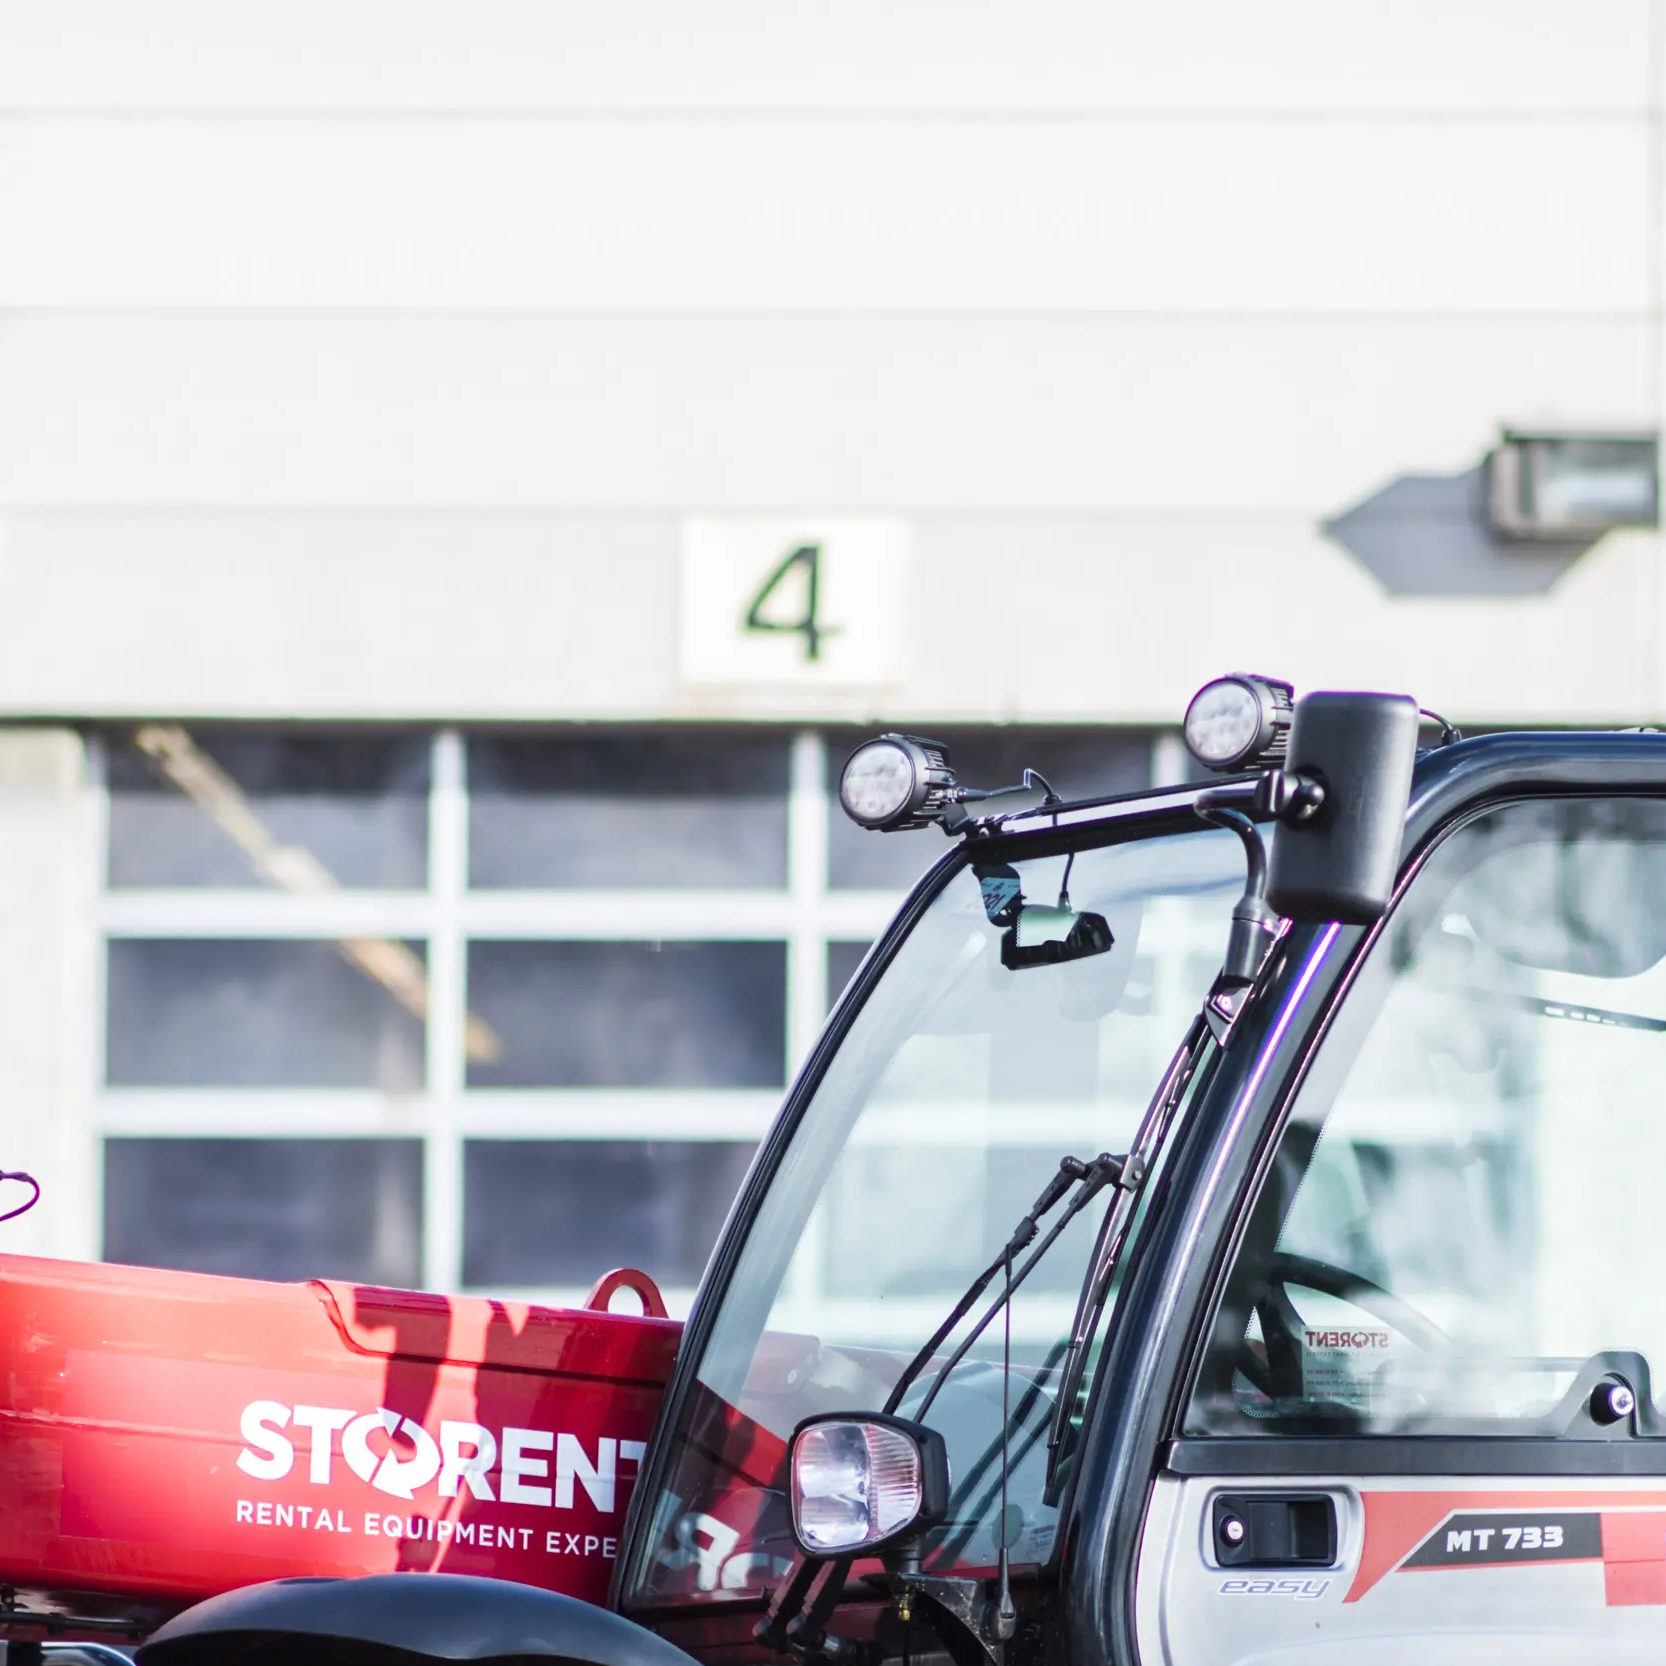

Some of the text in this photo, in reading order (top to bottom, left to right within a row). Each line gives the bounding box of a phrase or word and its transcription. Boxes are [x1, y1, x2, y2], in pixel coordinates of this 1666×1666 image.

[744, 543, 843, 661] 4
[236, 1500, 351, 1533] RENTAL
[365, 1513, 533, 1551] EQUIPMENT
[1447, 1526, 1564, 1553] MT 733
[1218, 1580, 1331, 1599] easy
